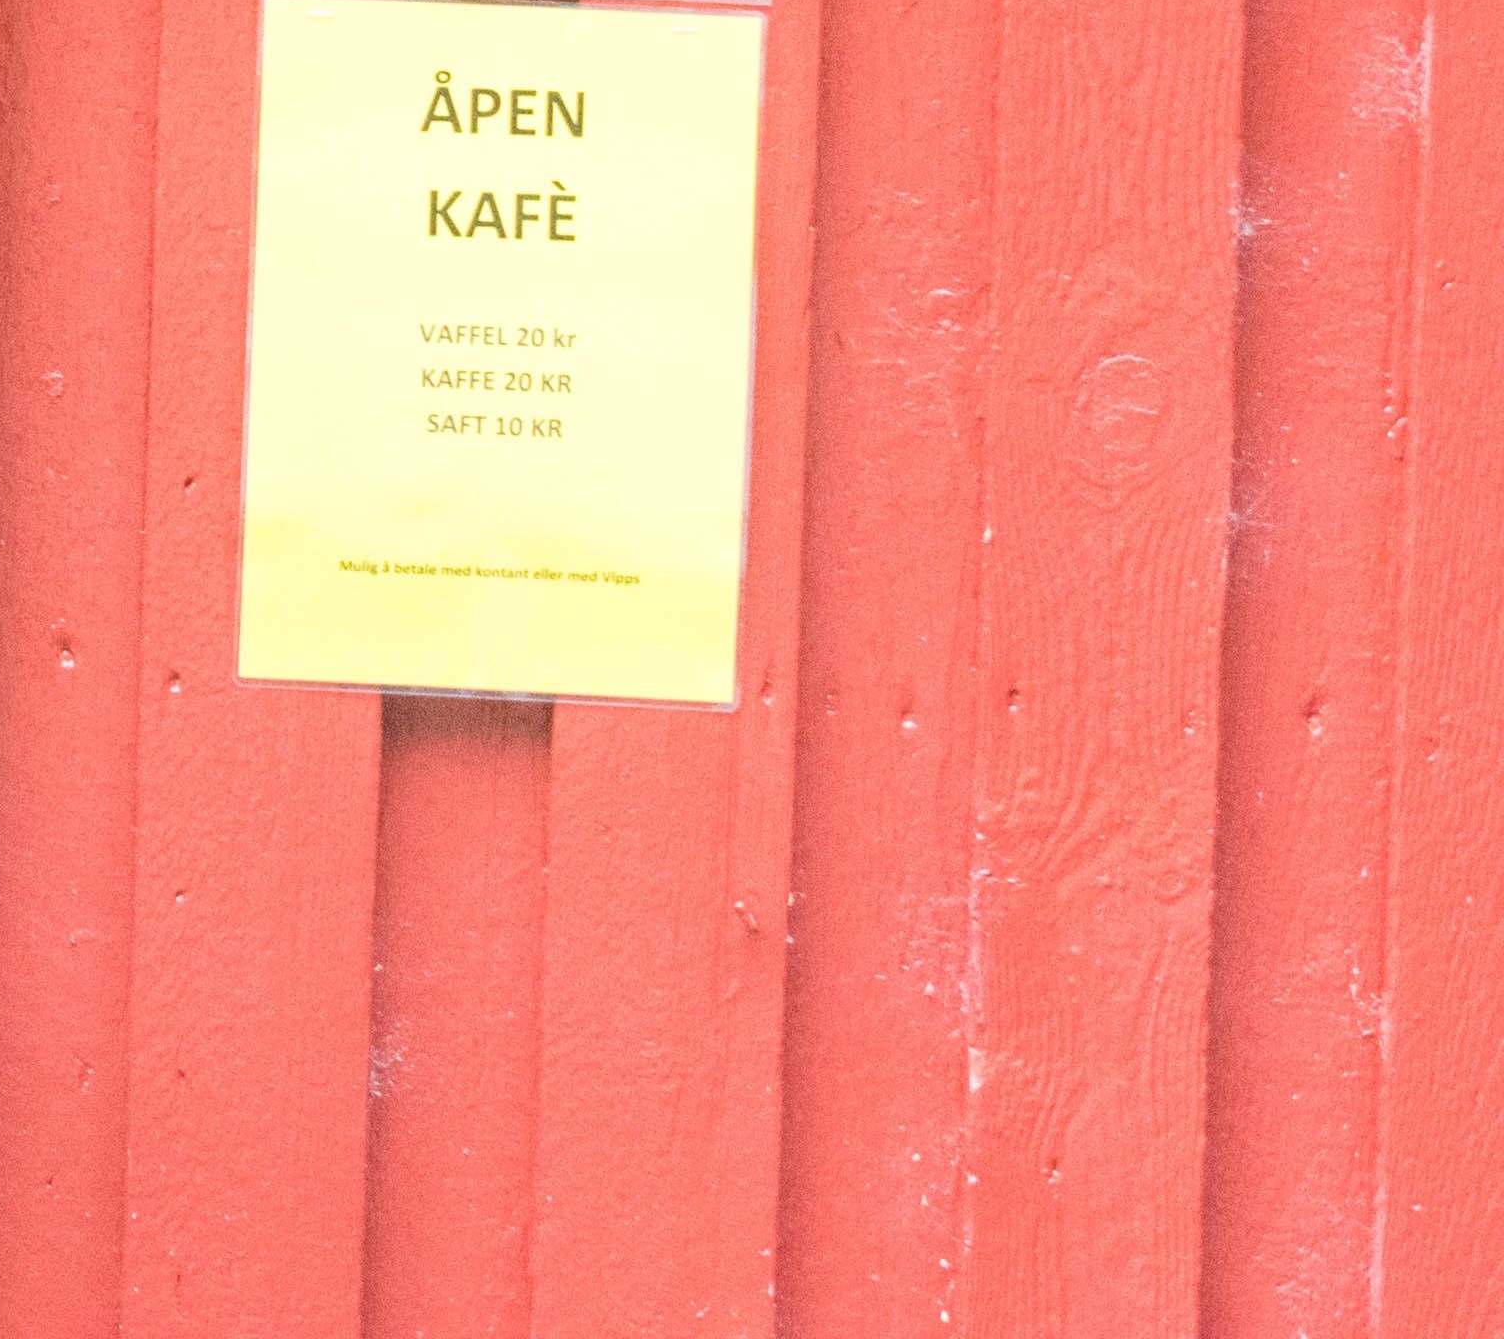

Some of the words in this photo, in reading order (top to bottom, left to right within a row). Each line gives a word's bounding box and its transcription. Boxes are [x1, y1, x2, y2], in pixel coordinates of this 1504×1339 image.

[420, 69, 586, 139] ÅPEN
[427, 179, 577, 243] KAFÈ
[419, 323, 508, 347] VAFFEL
[516, 326, 546, 348] 20
[552, 328, 577, 349] kr
[421, 368, 496, 392] KAFFE
[504, 371, 533, 393] 20
[540, 373, 572, 394] KR
[426, 412, 487, 435] SAFT
[496, 416, 523, 437] 10
[531, 418, 563, 439] KR
[338, 559, 379, 577] Mulig
[381, 560, 391, 574] å
[393, 562, 438, 577] betale
[440, 565, 472, 577] med
[474, 565, 530, 580] kontant
[532, 567, 564, 581] eller
[567, 570, 599, 583] med
[601, 571, 641, 587] Vipps
